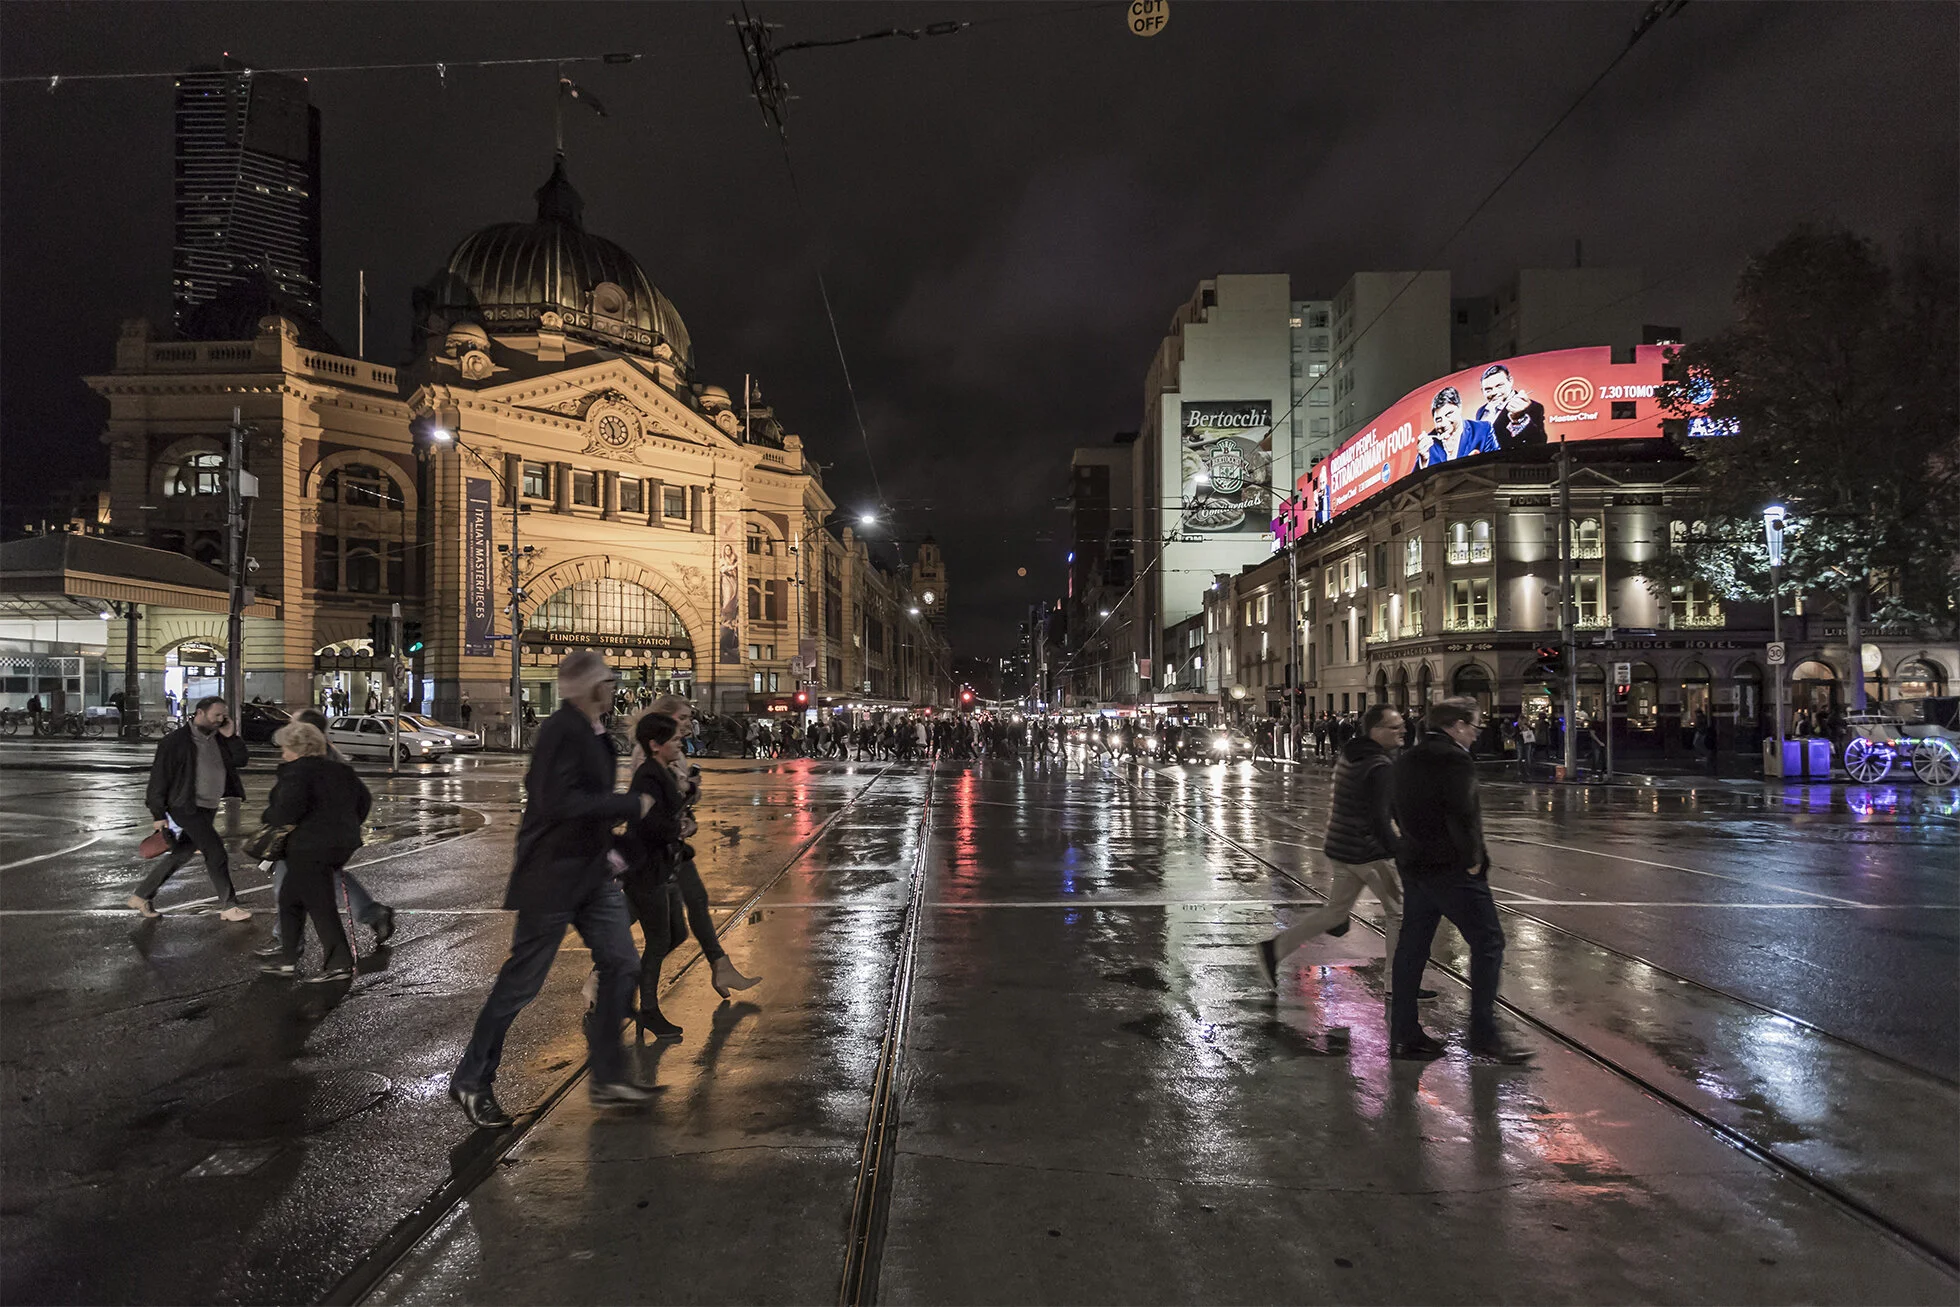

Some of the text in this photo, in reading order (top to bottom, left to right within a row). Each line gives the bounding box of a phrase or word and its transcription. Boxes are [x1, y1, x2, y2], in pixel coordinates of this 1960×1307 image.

[1132, 0, 1163, 15] CUT
[1134, 16, 1164, 32] OFF
[1599, 386, 1623, 399] 7.30
[1187, 409, 1267, 428] Bertocchi
[1549, 411, 1599, 424] MasterChef
[1330, 443, 1356, 475] ORDINARY
[1331, 438, 1388, 494] EXTRAORDINARY
[1387, 421, 1416, 458] FOOD.
[1511, 495, 1549, 505] YOUNG
[474, 508, 485, 619] ITALIAN MASTERPIECES
[550, 634, 671, 646] FLINDERS STREET STATION
[1613, 641, 1672, 649] BRIDGE
[1770, 649, 1781, 658] 30
